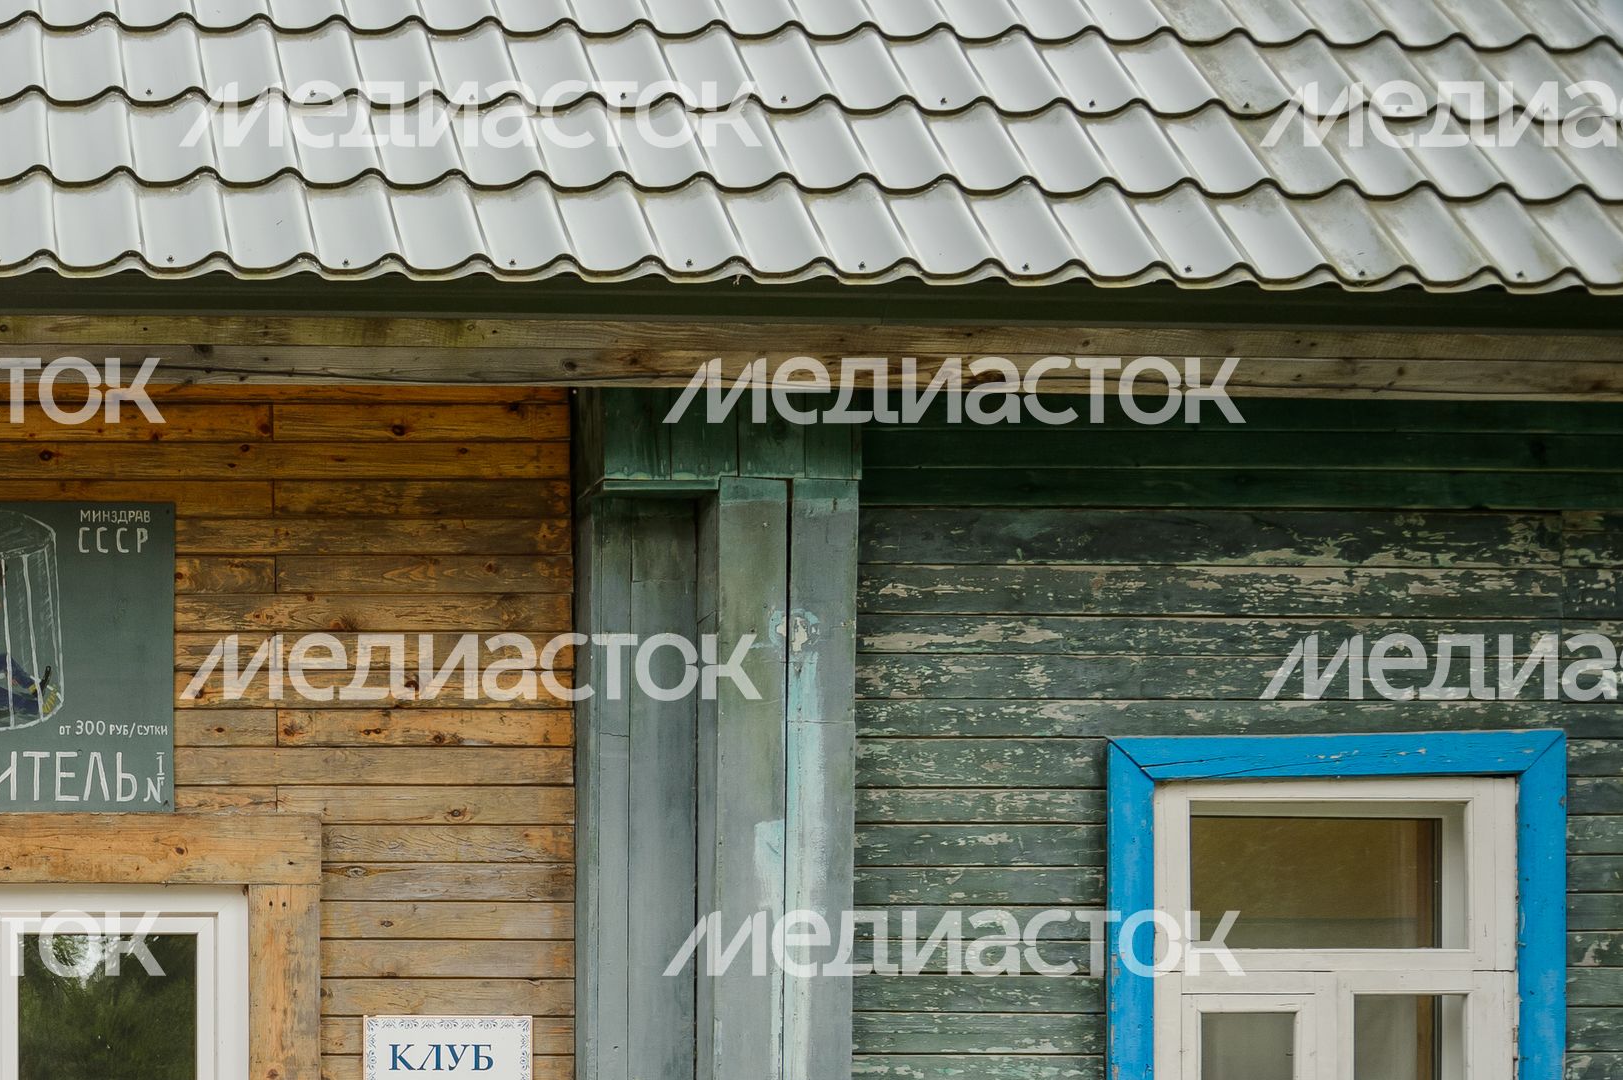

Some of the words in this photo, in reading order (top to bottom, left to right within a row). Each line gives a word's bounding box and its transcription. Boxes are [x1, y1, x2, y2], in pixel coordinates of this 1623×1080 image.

[79, 509, 151, 525] МИНЗДРАВ
[78, 526, 149, 554] СССР
[75, 719, 106, 736] 300
[109, 723, 168, 738] РУБ/СУТКИ
[388, 1044, 494, 1071] КЛУБ
